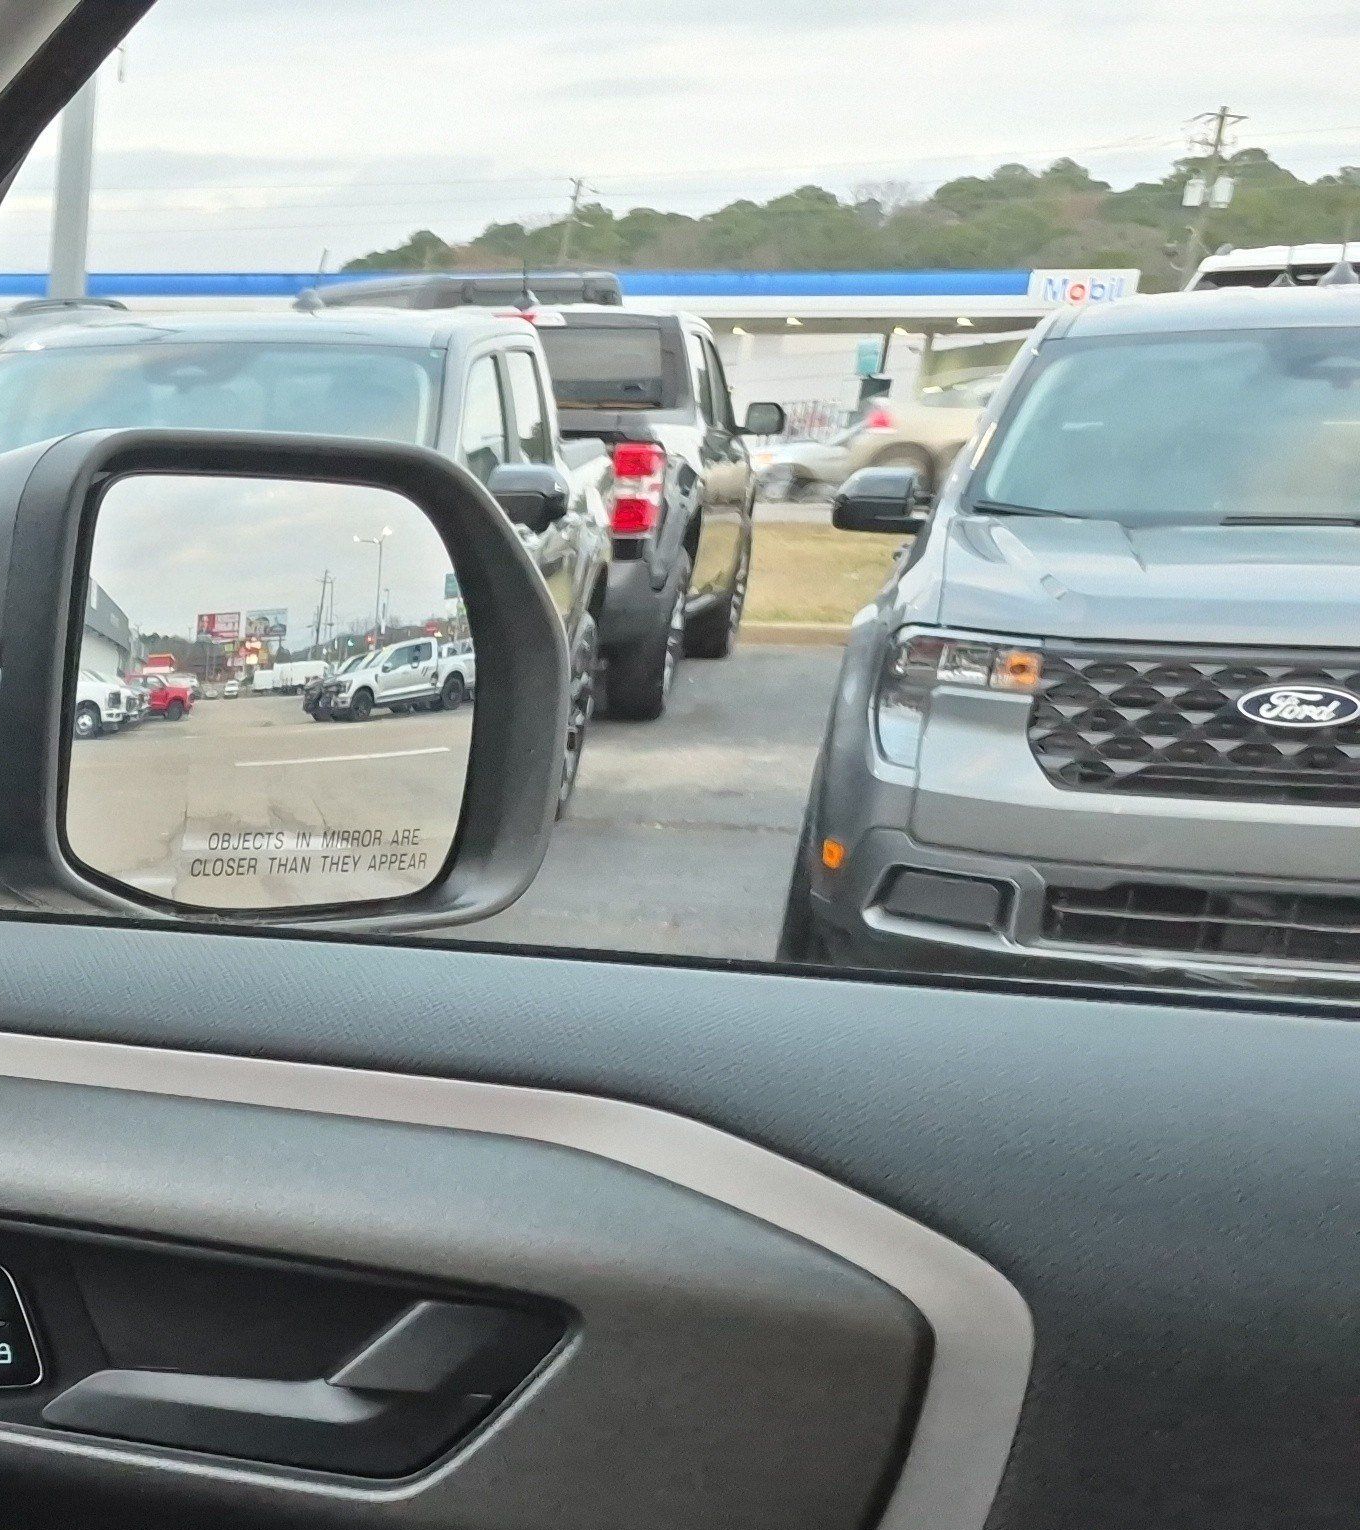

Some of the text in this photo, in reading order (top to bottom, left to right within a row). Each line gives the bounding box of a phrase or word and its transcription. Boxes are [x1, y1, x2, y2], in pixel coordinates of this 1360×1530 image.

[1044, 278, 1125, 302] Mobil
[1259, 691, 1341, 721] Ford
[208, 828, 421, 851] OBJECTS IN MIRROR ARE
[190, 852, 428, 878] CLOSER THAN THEY APPEAR
